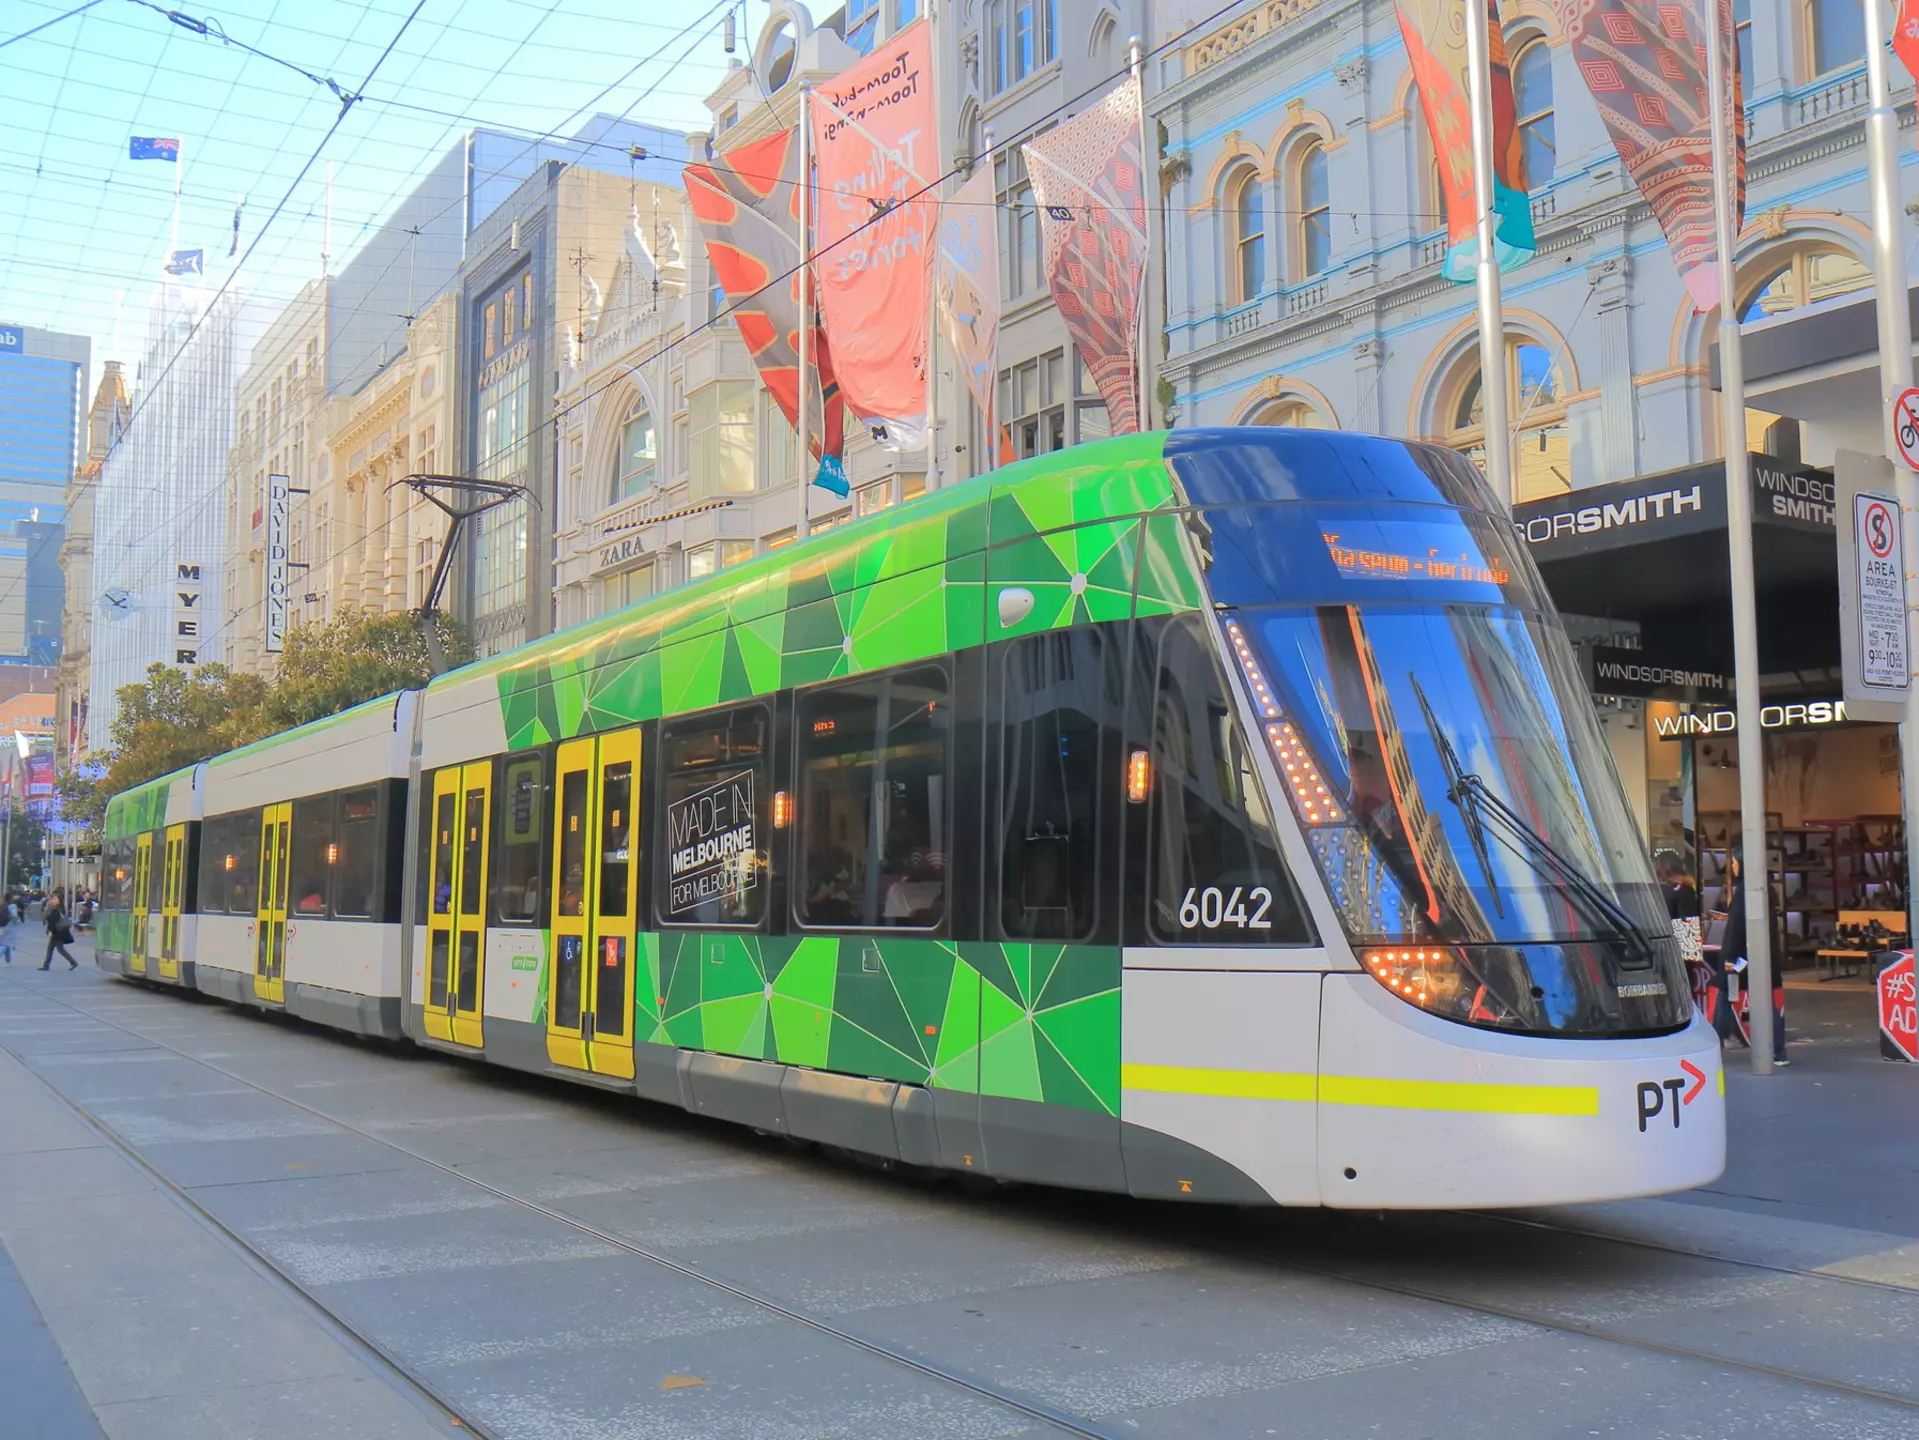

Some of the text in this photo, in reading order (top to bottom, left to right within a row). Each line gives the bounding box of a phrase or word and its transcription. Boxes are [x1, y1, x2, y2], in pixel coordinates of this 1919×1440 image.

[1051, 208, 1070, 219] 40
[1772, 494, 1837, 526] SMITH
[270, 486, 287, 644] DAVID JONES
[600, 536, 645, 567] ZARA
[1866, 561, 1897, 577] AREA
[176, 564, 200, 664] MYER
[1597, 661, 1723, 690] WINDSORSMITH
[1654, 700, 1845, 736] WINDORS
[671, 778, 751, 849] MADE IN
[672, 824, 752, 875] MELBOURNE
[673, 882, 692, 906] FOR
[1179, 886, 1273, 929] 6042
